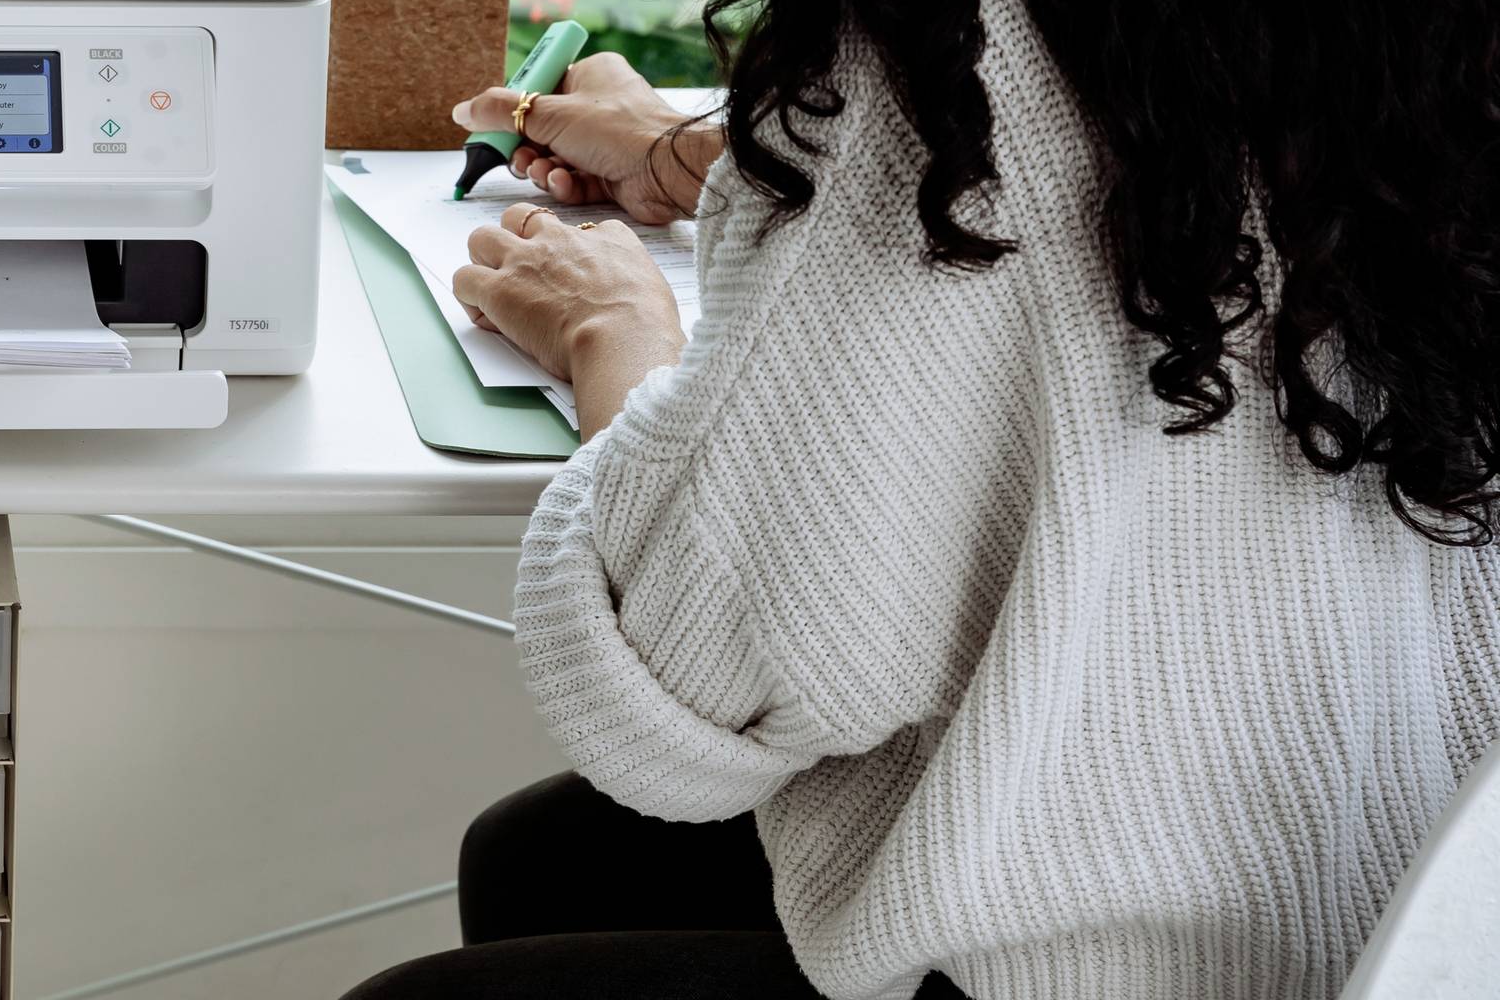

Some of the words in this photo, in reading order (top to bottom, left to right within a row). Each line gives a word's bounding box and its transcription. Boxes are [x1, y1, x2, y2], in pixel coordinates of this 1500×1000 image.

[91, 50, 122, 59] BLACK
[94, 144, 126, 153] COLOR
[229, 319, 269, 330] TS7750i
